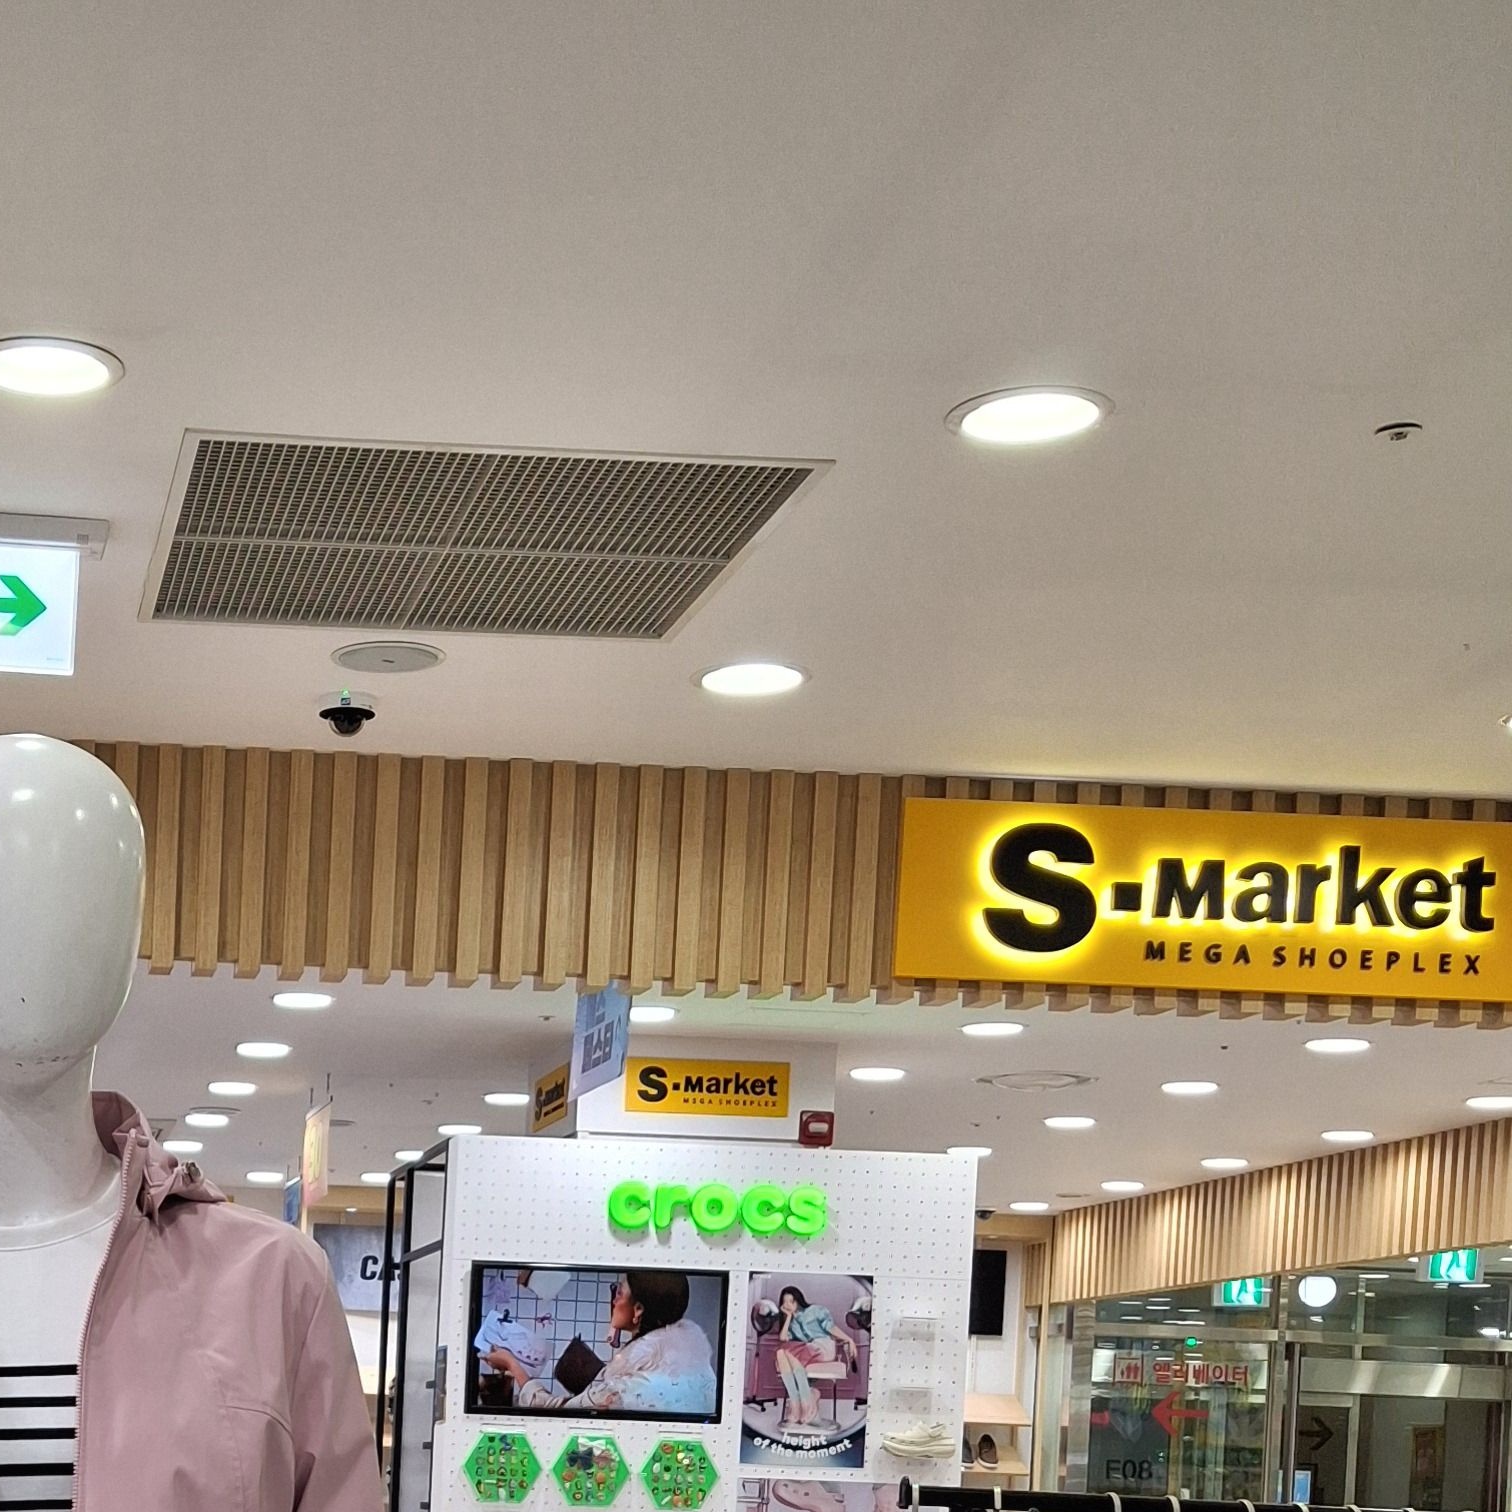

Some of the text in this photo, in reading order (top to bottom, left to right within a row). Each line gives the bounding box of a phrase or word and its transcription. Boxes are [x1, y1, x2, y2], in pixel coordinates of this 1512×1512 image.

[1144, 939, 1481, 976] MEGA SHOEPLEX
[608, 1179, 827, 1238] crocs
[753, 1437, 853, 1459] of the moment
[782, 1431, 827, 1449] height
